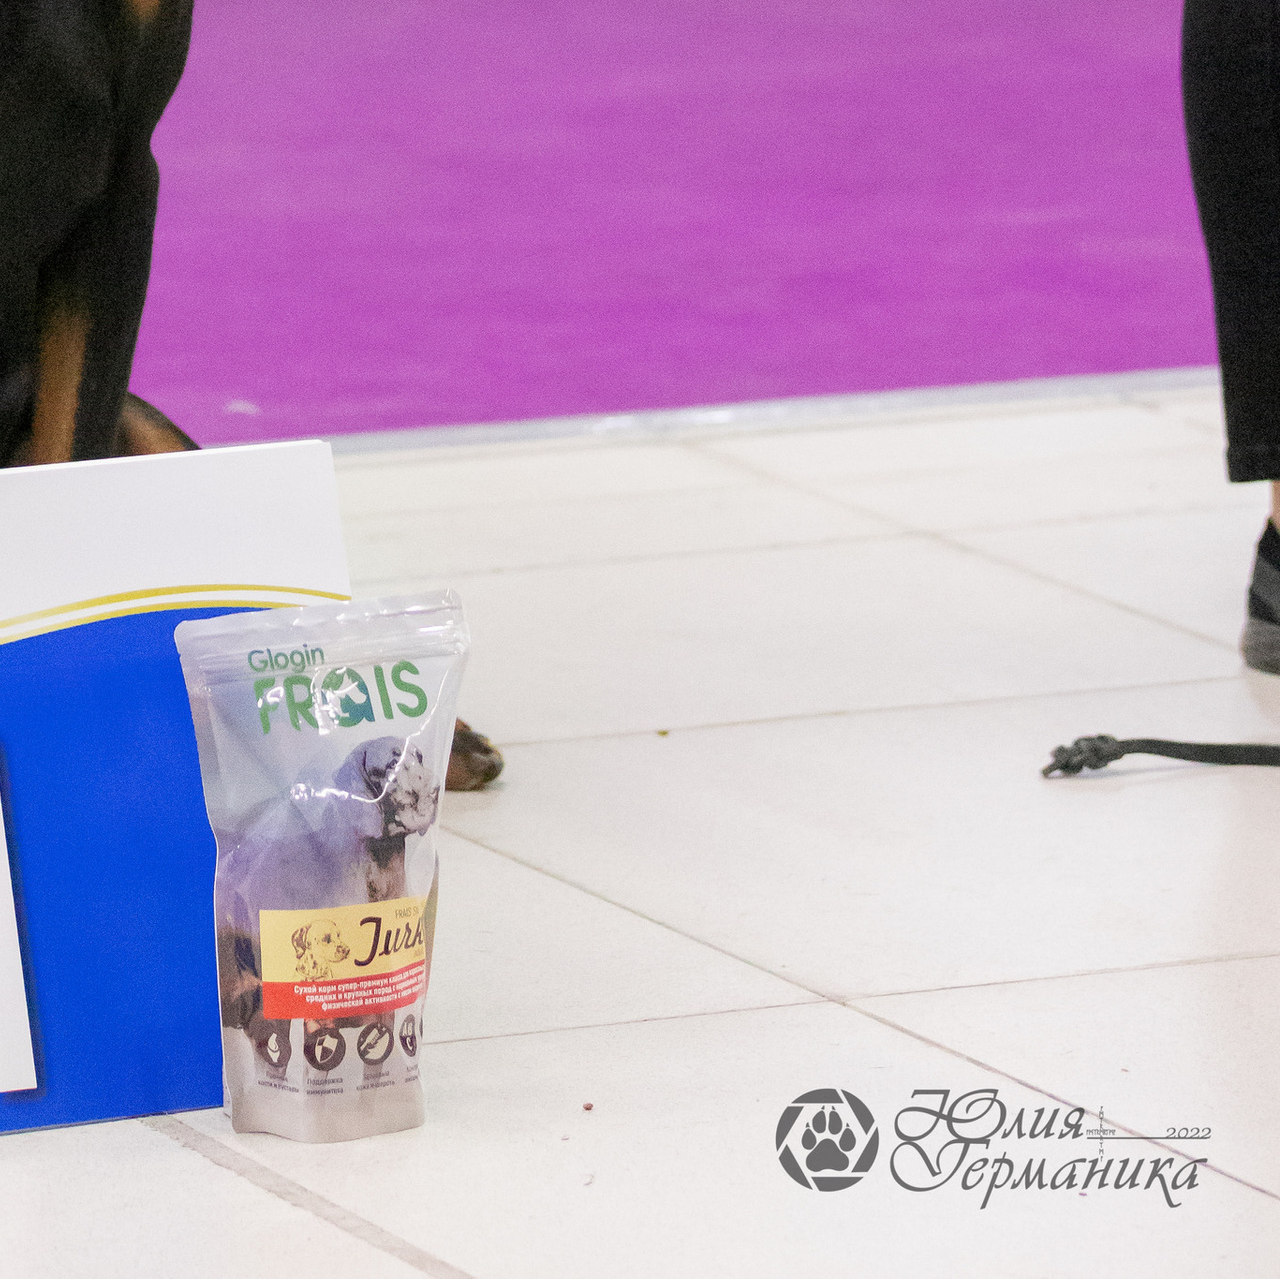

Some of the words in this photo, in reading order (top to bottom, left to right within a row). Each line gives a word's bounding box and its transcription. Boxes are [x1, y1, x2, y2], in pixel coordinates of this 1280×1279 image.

[247, 643, 325, 674] Glogin
[294, 984, 317, 995] Сухой
[318, 984, 337, 994] корм
